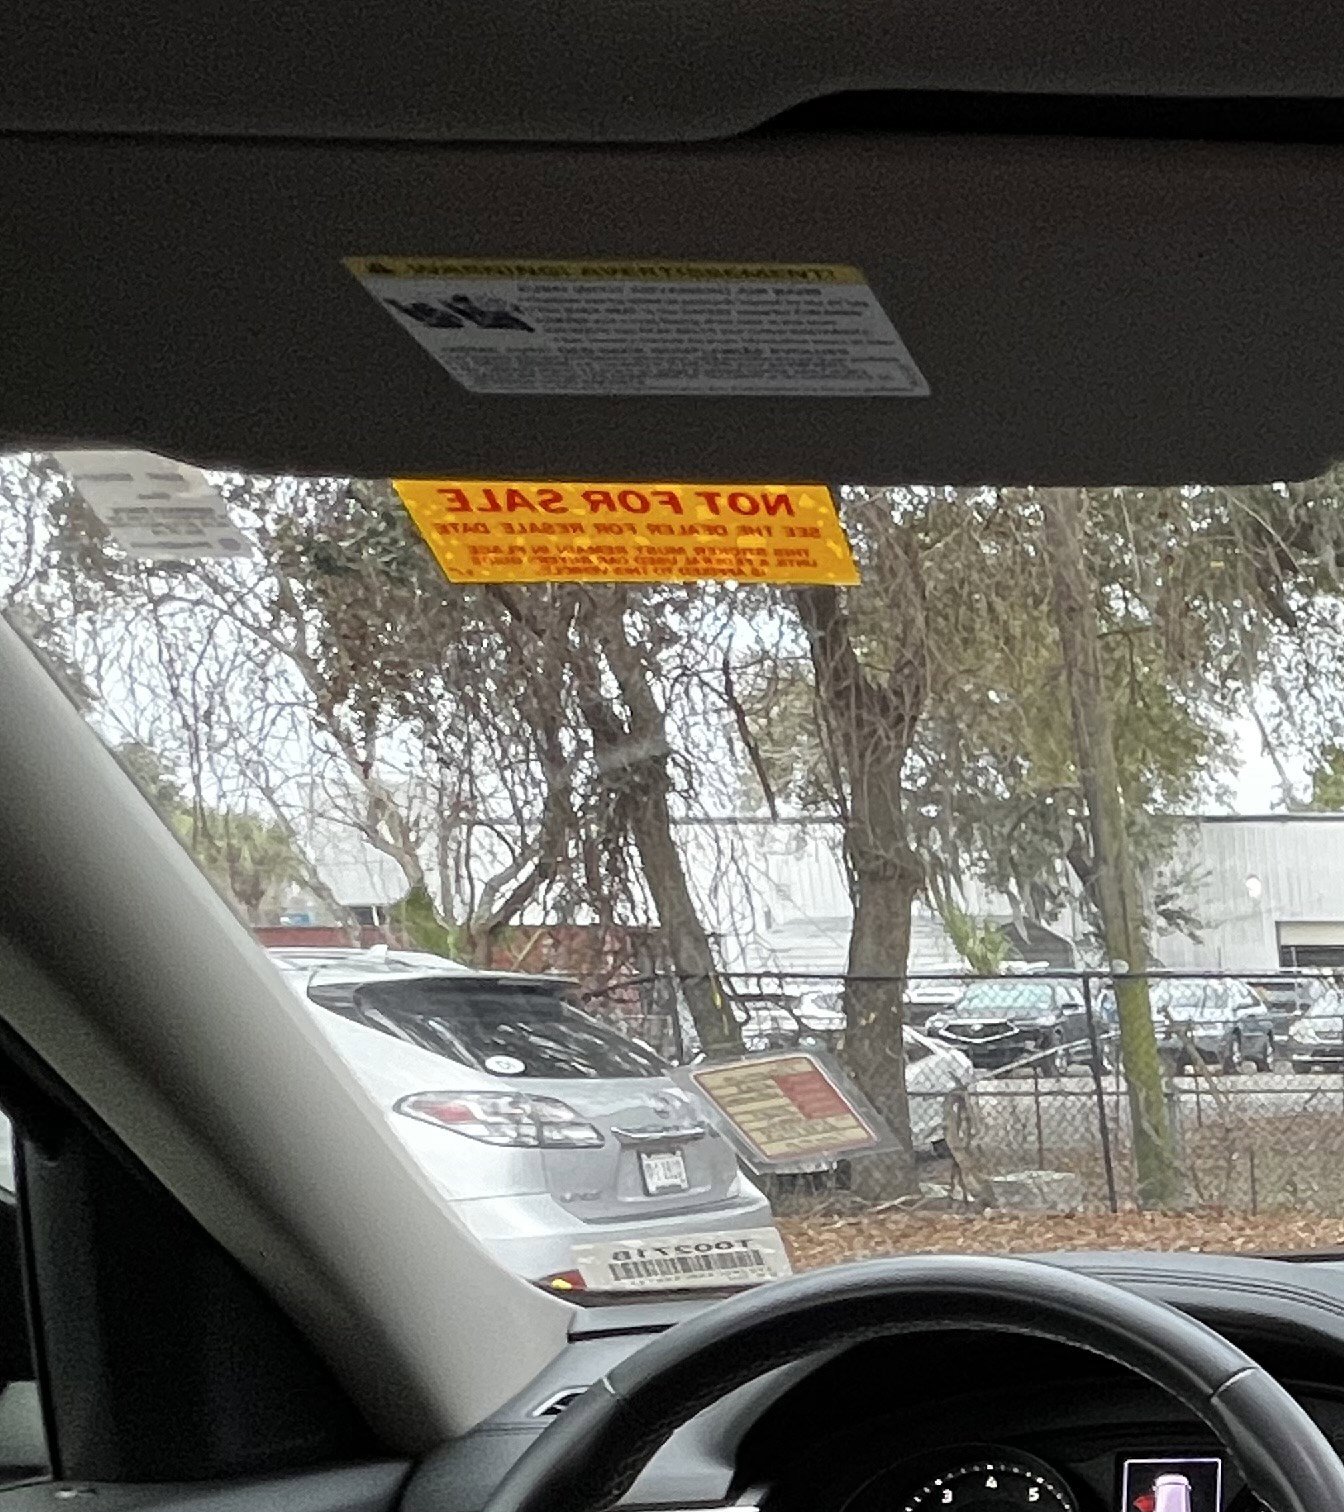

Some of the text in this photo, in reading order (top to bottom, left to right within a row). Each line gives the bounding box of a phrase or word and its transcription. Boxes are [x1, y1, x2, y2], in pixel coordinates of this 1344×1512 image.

[985, 1475, 998, 1488] 4
[941, 1489, 953, 1504] 3
[1028, 1487, 1040, 1502] 5
